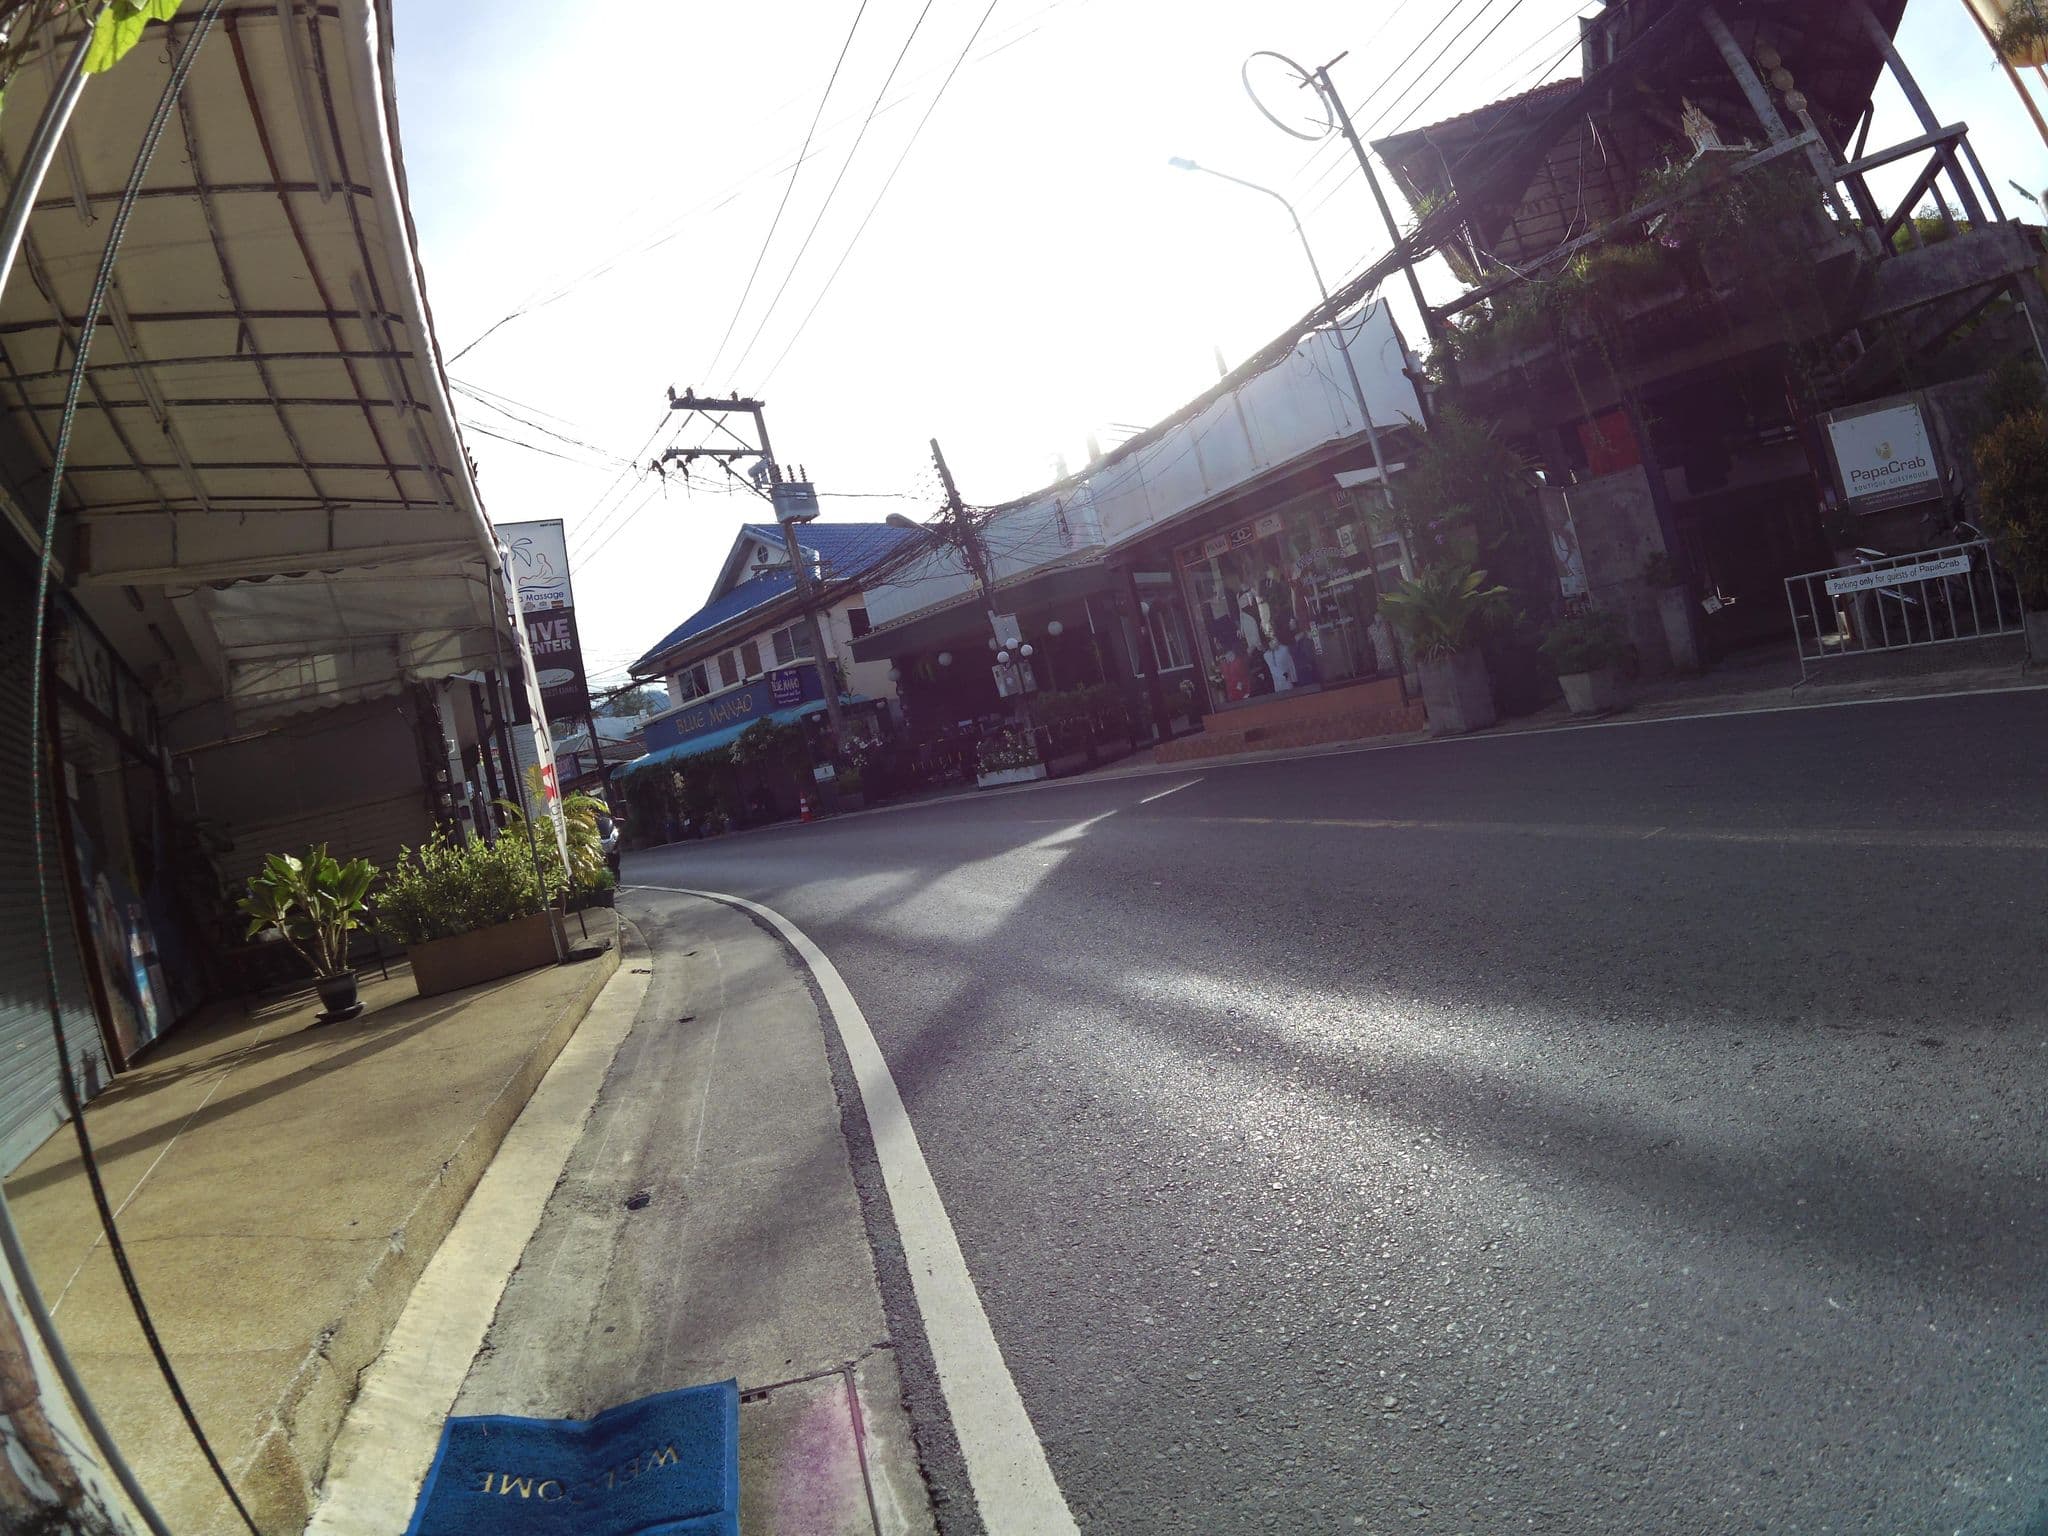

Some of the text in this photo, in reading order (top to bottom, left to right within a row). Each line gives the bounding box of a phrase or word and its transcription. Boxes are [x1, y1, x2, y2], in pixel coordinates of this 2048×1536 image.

[1851, 456, 1926, 482] PapaCrab
[1833, 559, 1960, 590] Parking only for guests of PapaCrab
[526, 590, 564, 602] Massage
[521, 639, 573, 656] ENTER
